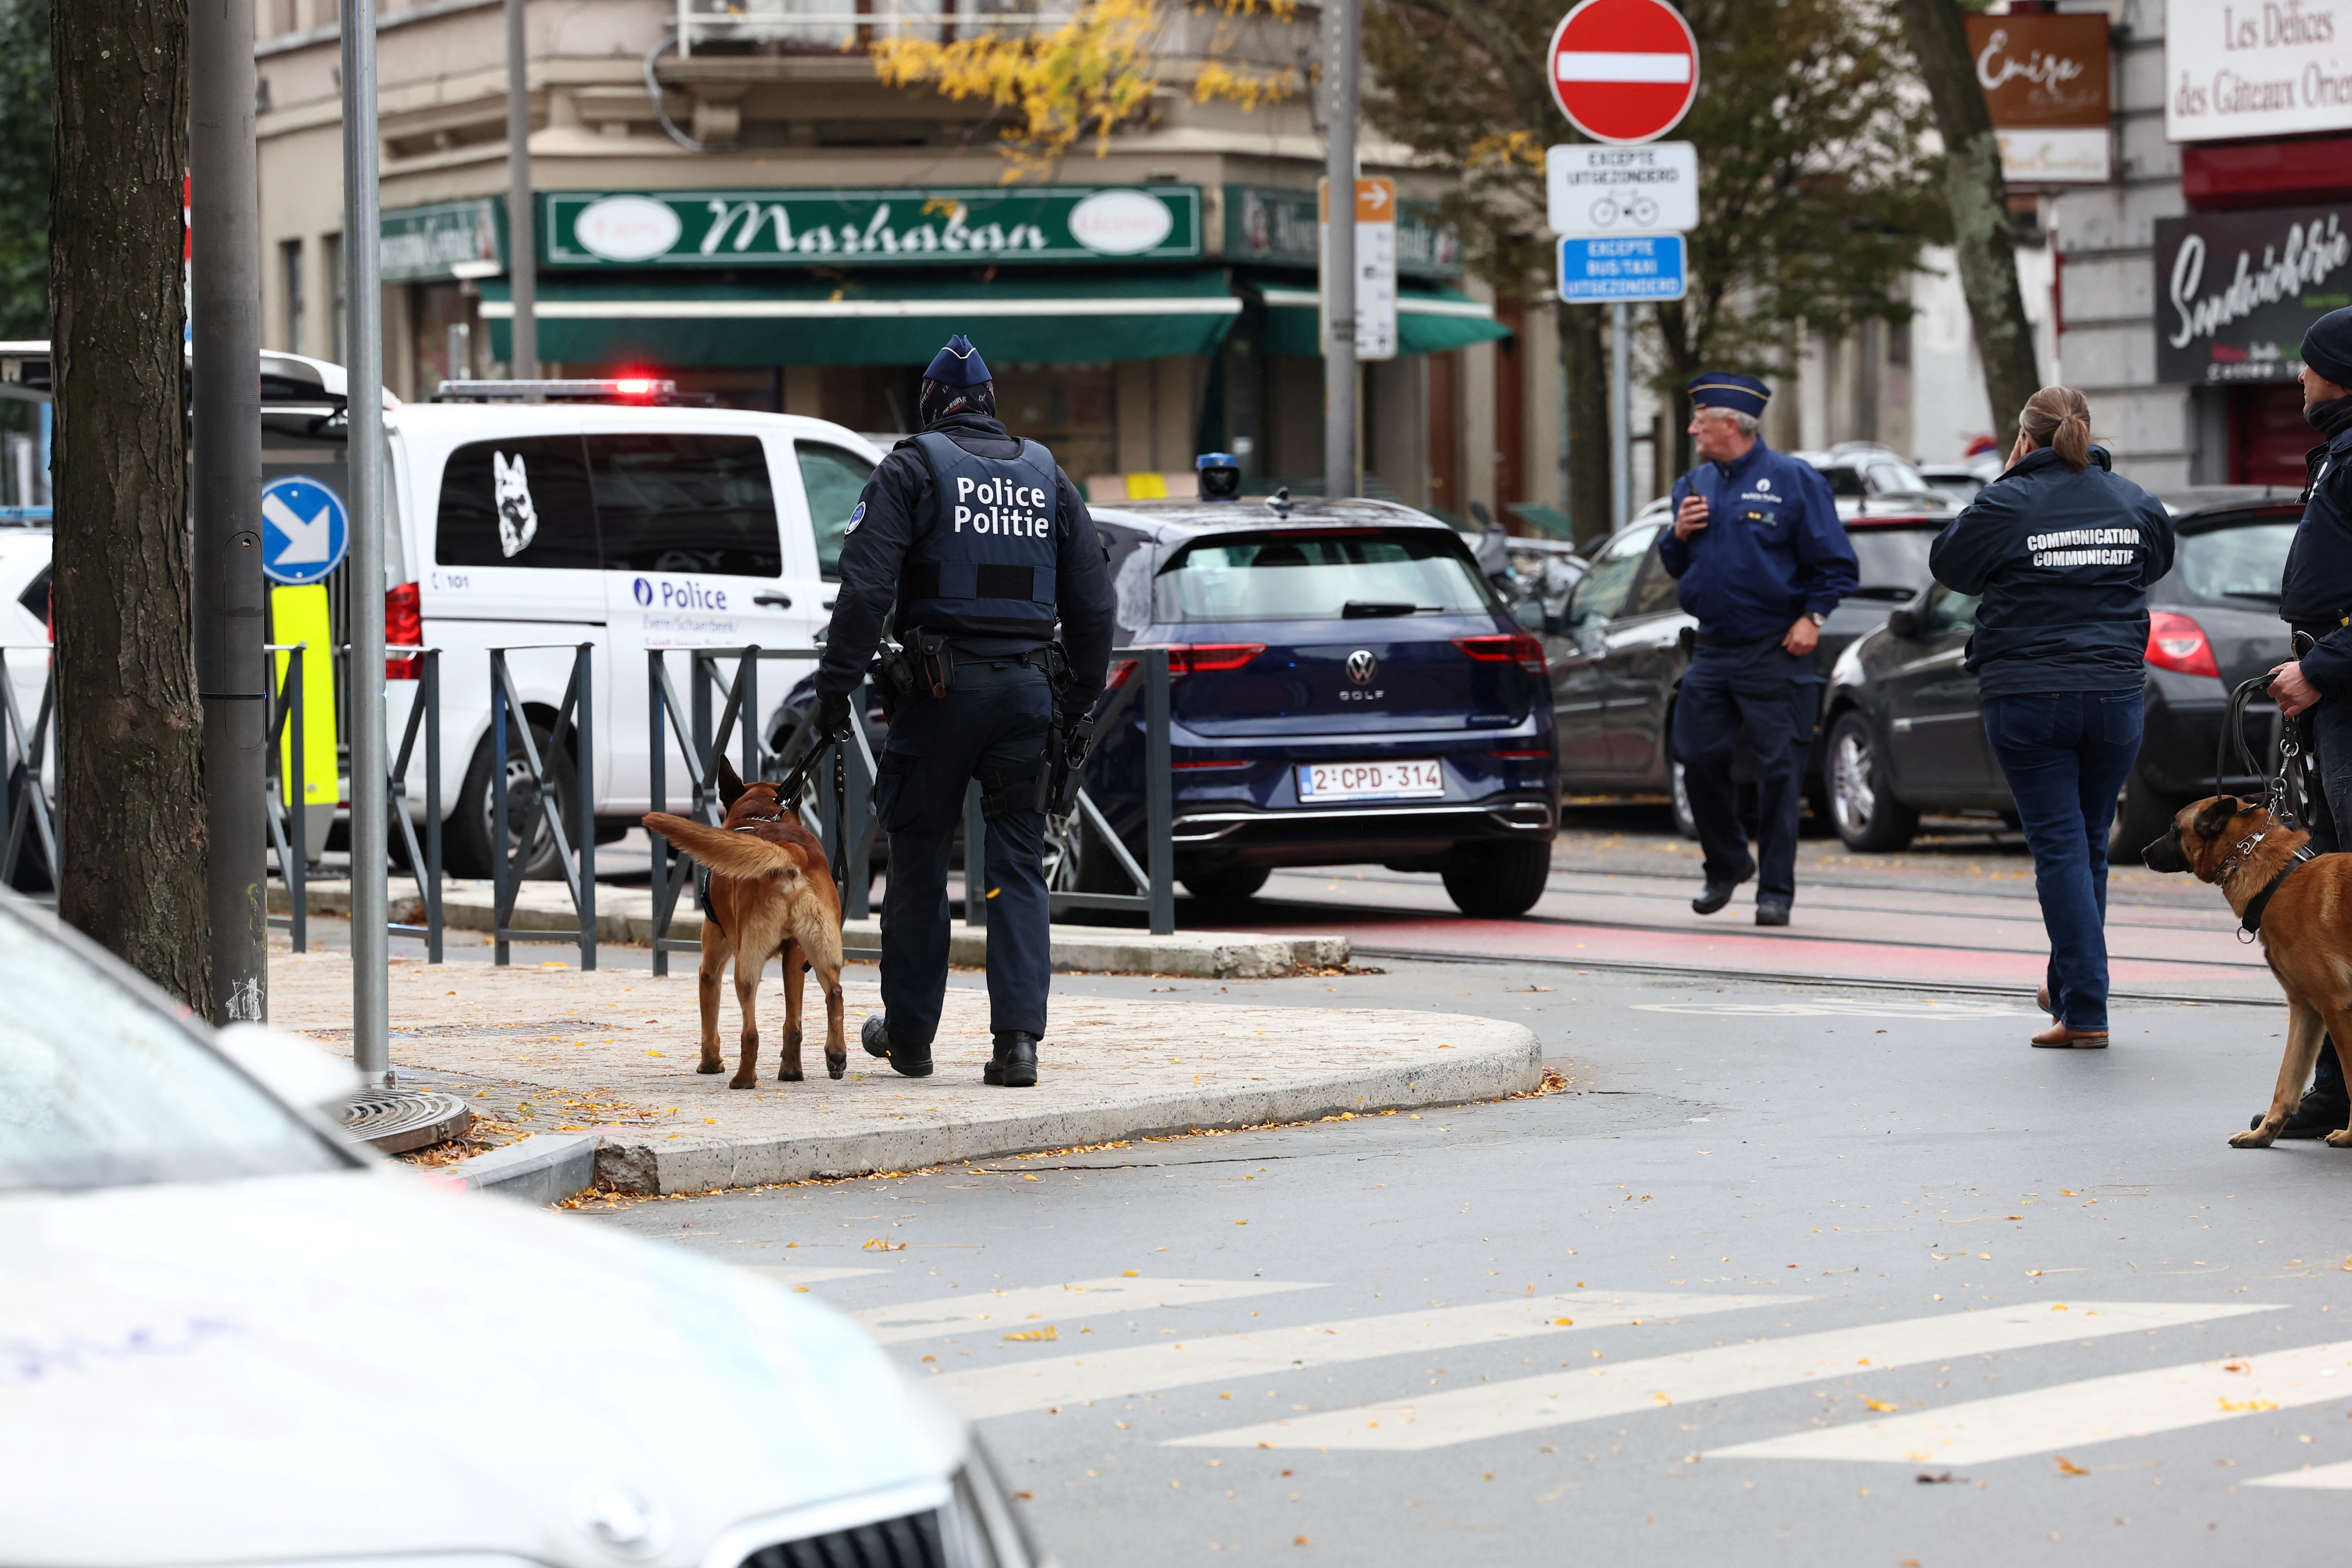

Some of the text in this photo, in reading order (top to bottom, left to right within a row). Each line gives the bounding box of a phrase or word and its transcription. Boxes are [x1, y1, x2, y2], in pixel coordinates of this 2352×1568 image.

[2224, 5, 2258, 51] Les
[2174, 71, 2207, 116] des
[1567, 167, 1680, 186] UITGEZONDERD
[700, 198, 1050, 256] Marhaban
[1586, 259, 1657, 276] BUS TAXI
[1566, 277, 1680, 296] UITGEZONDERD
[957, 477, 1045, 508] Police
[955, 506, 1049, 538] Politie
[2027, 529, 2140, 552] COMMUNICATION
[447, 575, 469, 588] 101
[661, 581, 727, 610] Police
[1339, 690, 1385, 701] GOLF
